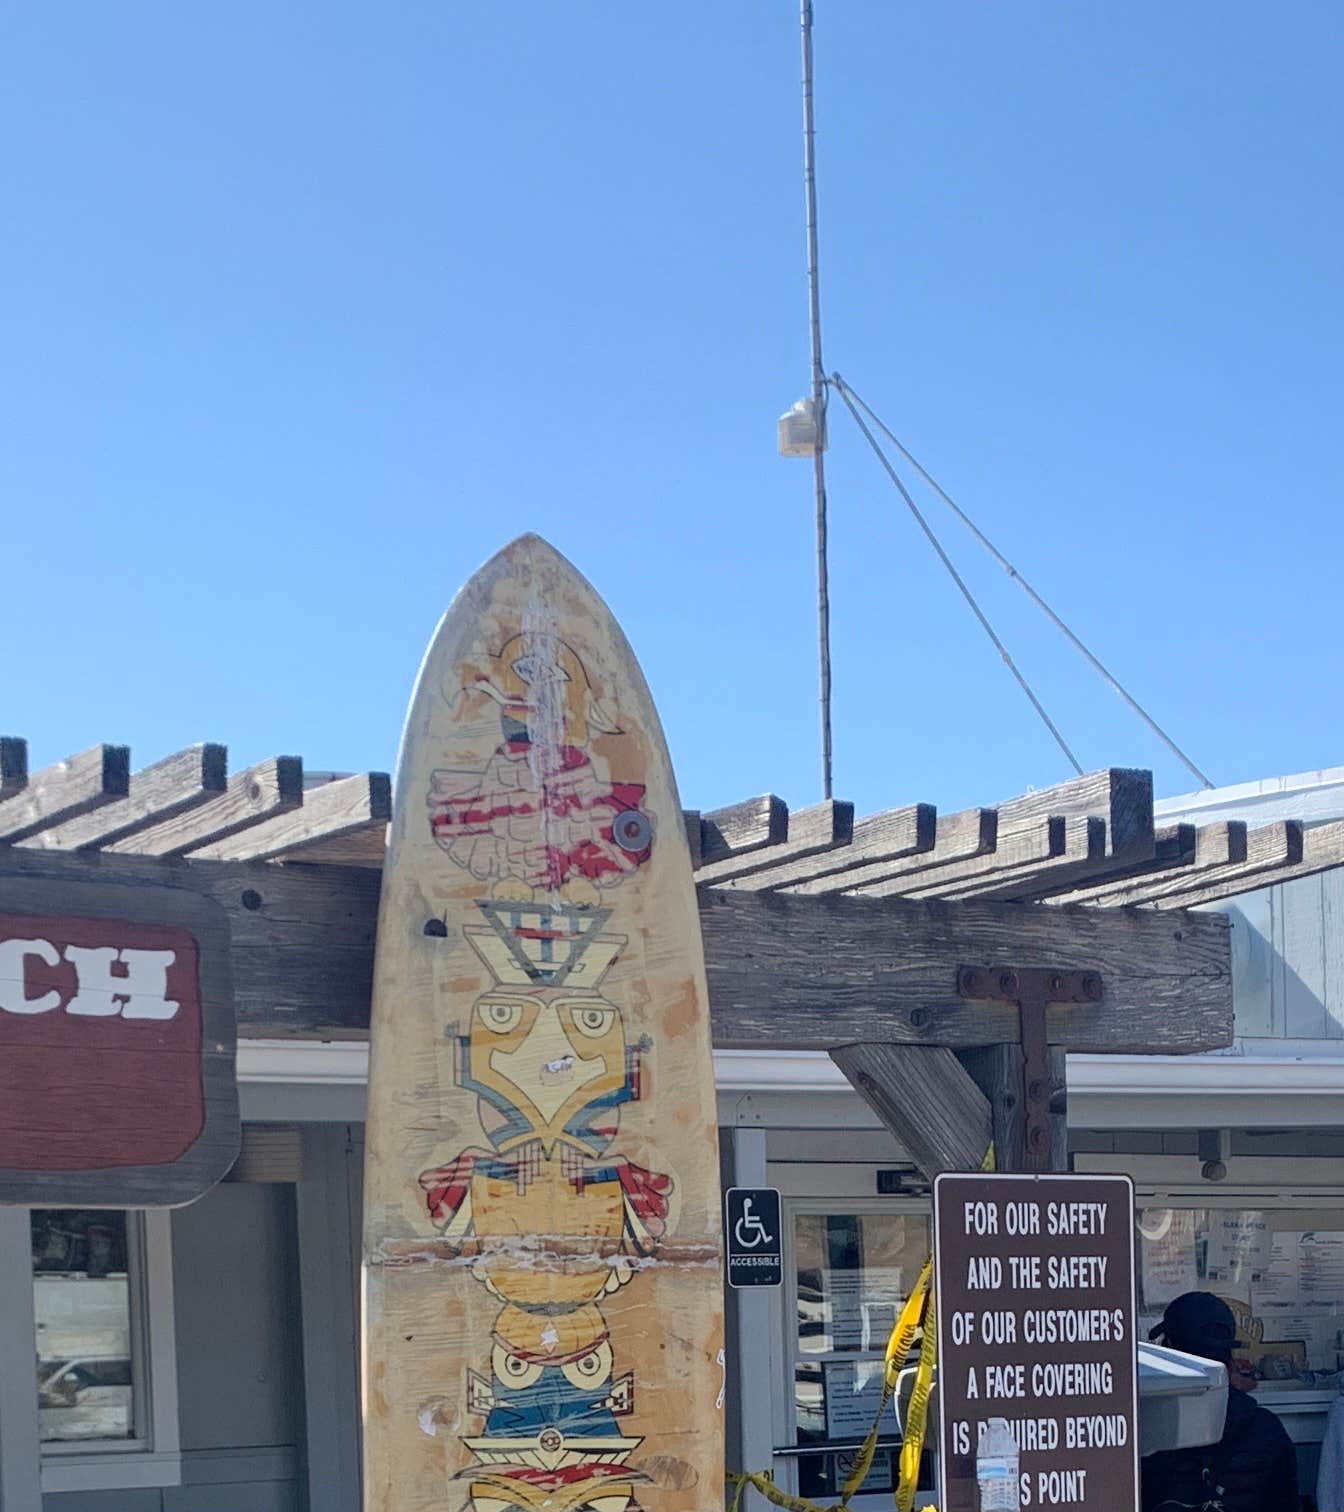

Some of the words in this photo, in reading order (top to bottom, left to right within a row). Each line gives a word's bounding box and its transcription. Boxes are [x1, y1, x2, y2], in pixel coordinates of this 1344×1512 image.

[964, 1202, 998, 1235] FOR
[1006, 1202, 1040, 1235] OUR
[1047, 1202, 1107, 1235] SAFETY
[730, 1256, 780, 1267] ACCESSIBLE
[967, 1257, 1002, 1290] AND
[1009, 1257, 1041, 1289] THE
[1047, 1256, 1107, 1289] SAFETY
[951, 1312, 975, 1345] OF
[982, 1311, 1017, 1344] OUR
[1023, 1309, 1124, 1343] CUSTOMER'S
[967, 1366, 979, 1399] A
[986, 1365, 1025, 1398] FACE
[1032, 1362, 1112, 1397] COVERING
[952, 1421, 969, 1454] IS
[978, 1417, 1059, 1453] UIRED
[1066, 1415, 1127, 1449] BEYOND
[1038, 1470, 1087, 1505] POINT
